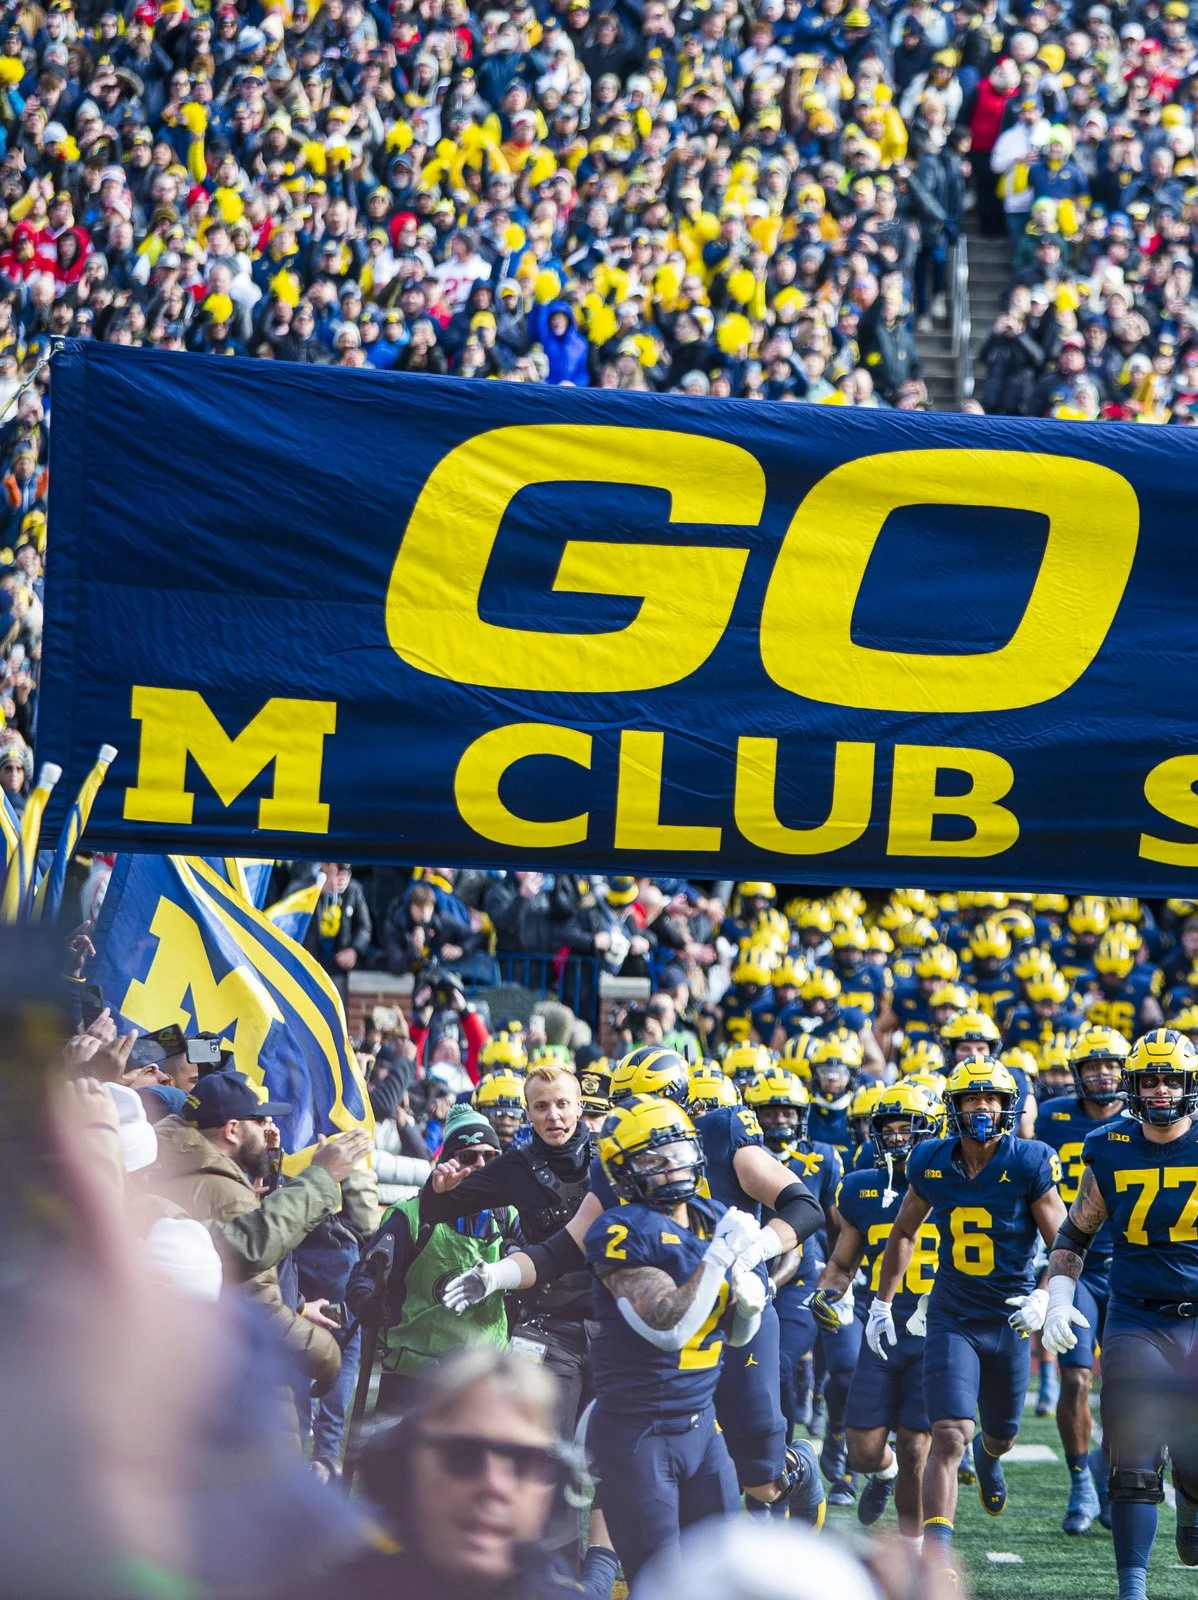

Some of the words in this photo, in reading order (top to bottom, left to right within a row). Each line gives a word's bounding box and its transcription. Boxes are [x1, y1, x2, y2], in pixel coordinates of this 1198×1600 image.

[386, 424, 1140, 713] GO
[123, 686, 337, 834] M
[454, 723, 1019, 858] CLUB
[605, 1225, 628, 1260] 2
[950, 1206, 995, 1276] 6
